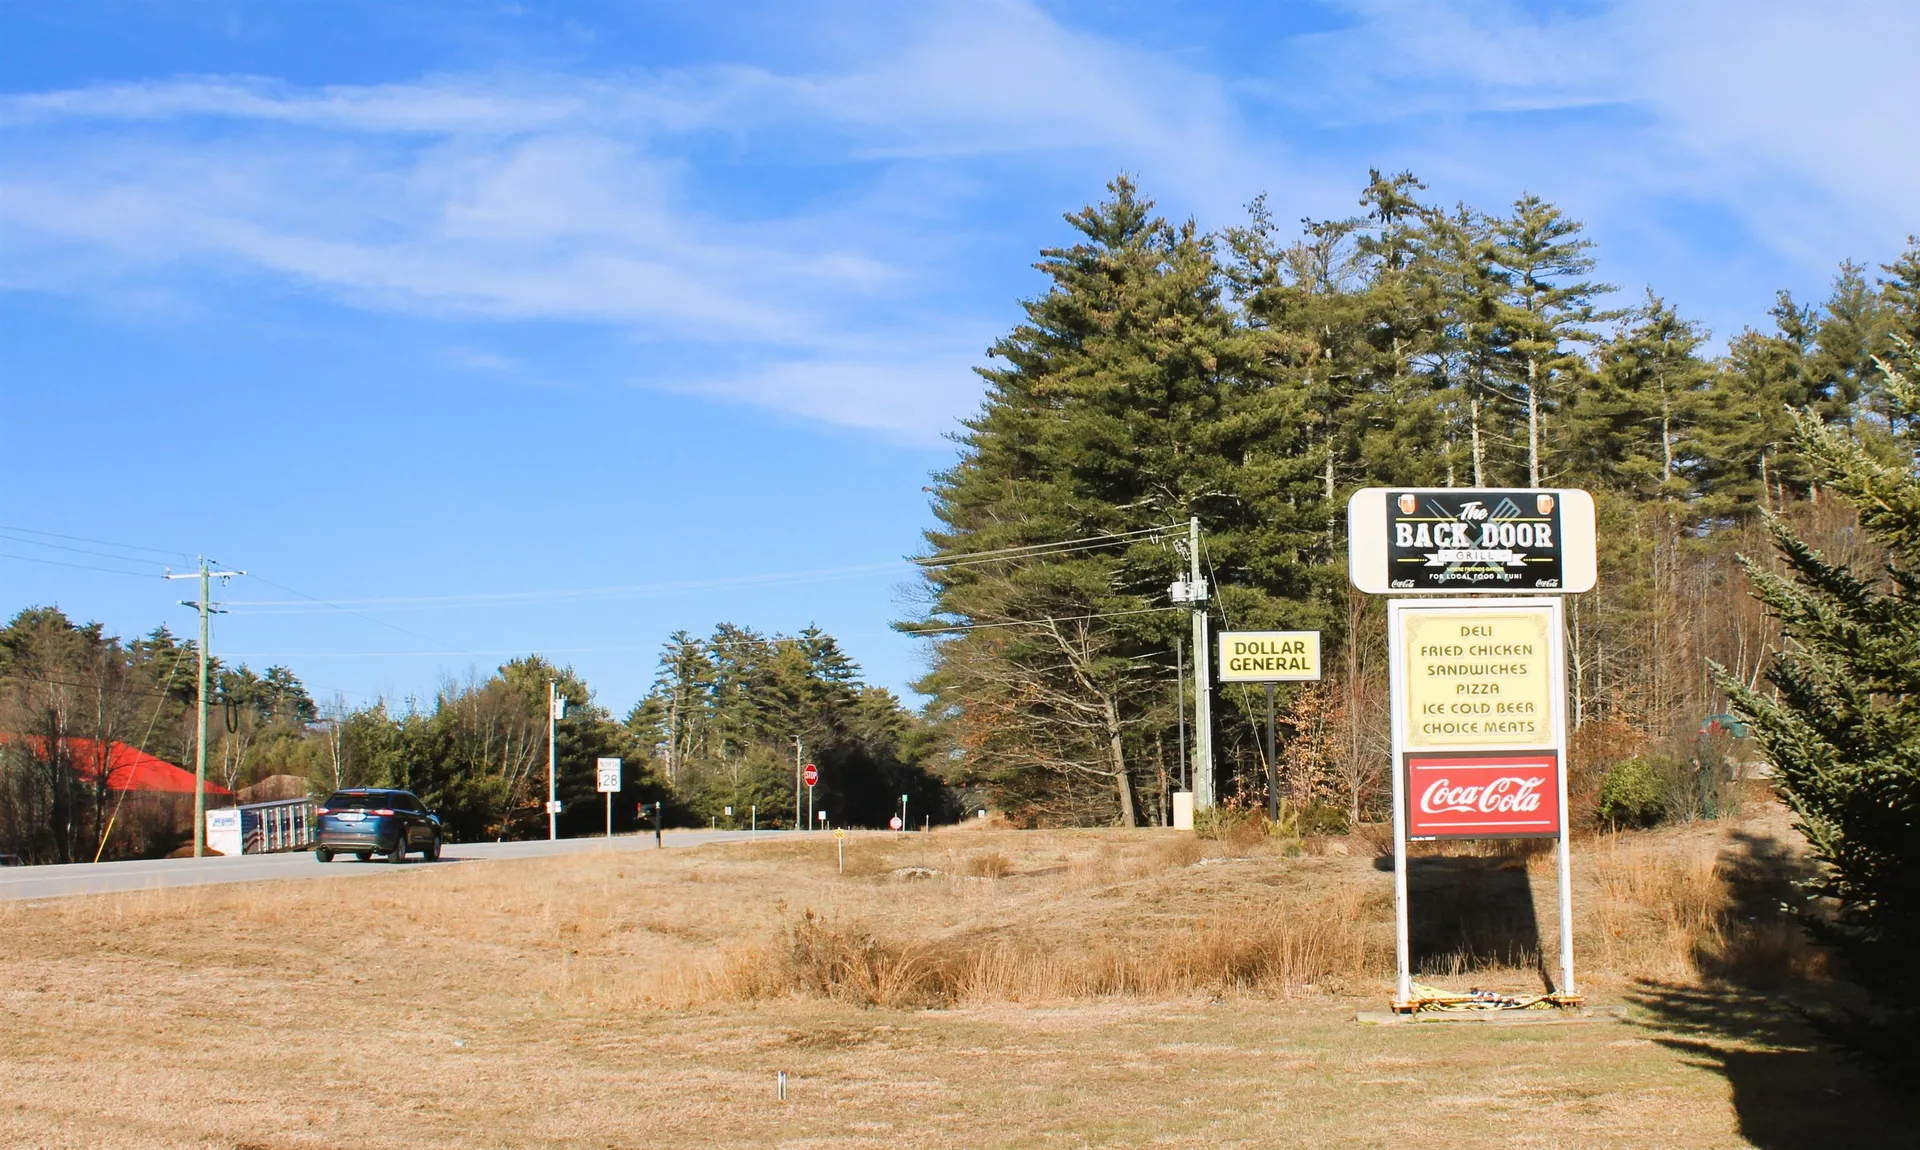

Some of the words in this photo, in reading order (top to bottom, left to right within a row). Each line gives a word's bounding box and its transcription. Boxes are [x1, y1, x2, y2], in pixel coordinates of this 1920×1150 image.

[1460, 501, 1488, 520] The
[1395, 523, 1470, 548] BACK
[1481, 523, 1553, 548] DOOR
[1456, 551, 1494, 560] GRILL
[1460, 626, 1492, 637] DELI
[1234, 641, 1305, 655] DOLLAR
[1421, 645, 1463, 656] FRIED
[1469, 644, 1533, 656] CHICKEN
[1230, 657, 1310, 671] GENERAL
[1427, 664, 1528, 676] SANDWICHES
[1456, 683, 1500, 694] PIZZA
[1423, 703, 1445, 714] ICE
[1451, 703, 1491, 714] COLD
[1496, 702, 1535, 713] BEER
[1423, 722, 1478, 734] CHOICE
[1484, 721, 1535, 733] MEATS
[603, 774, 618, 787] 28
[805, 770, 818, 779] STOP
[1420, 777, 1546, 814] Coca-Cola
